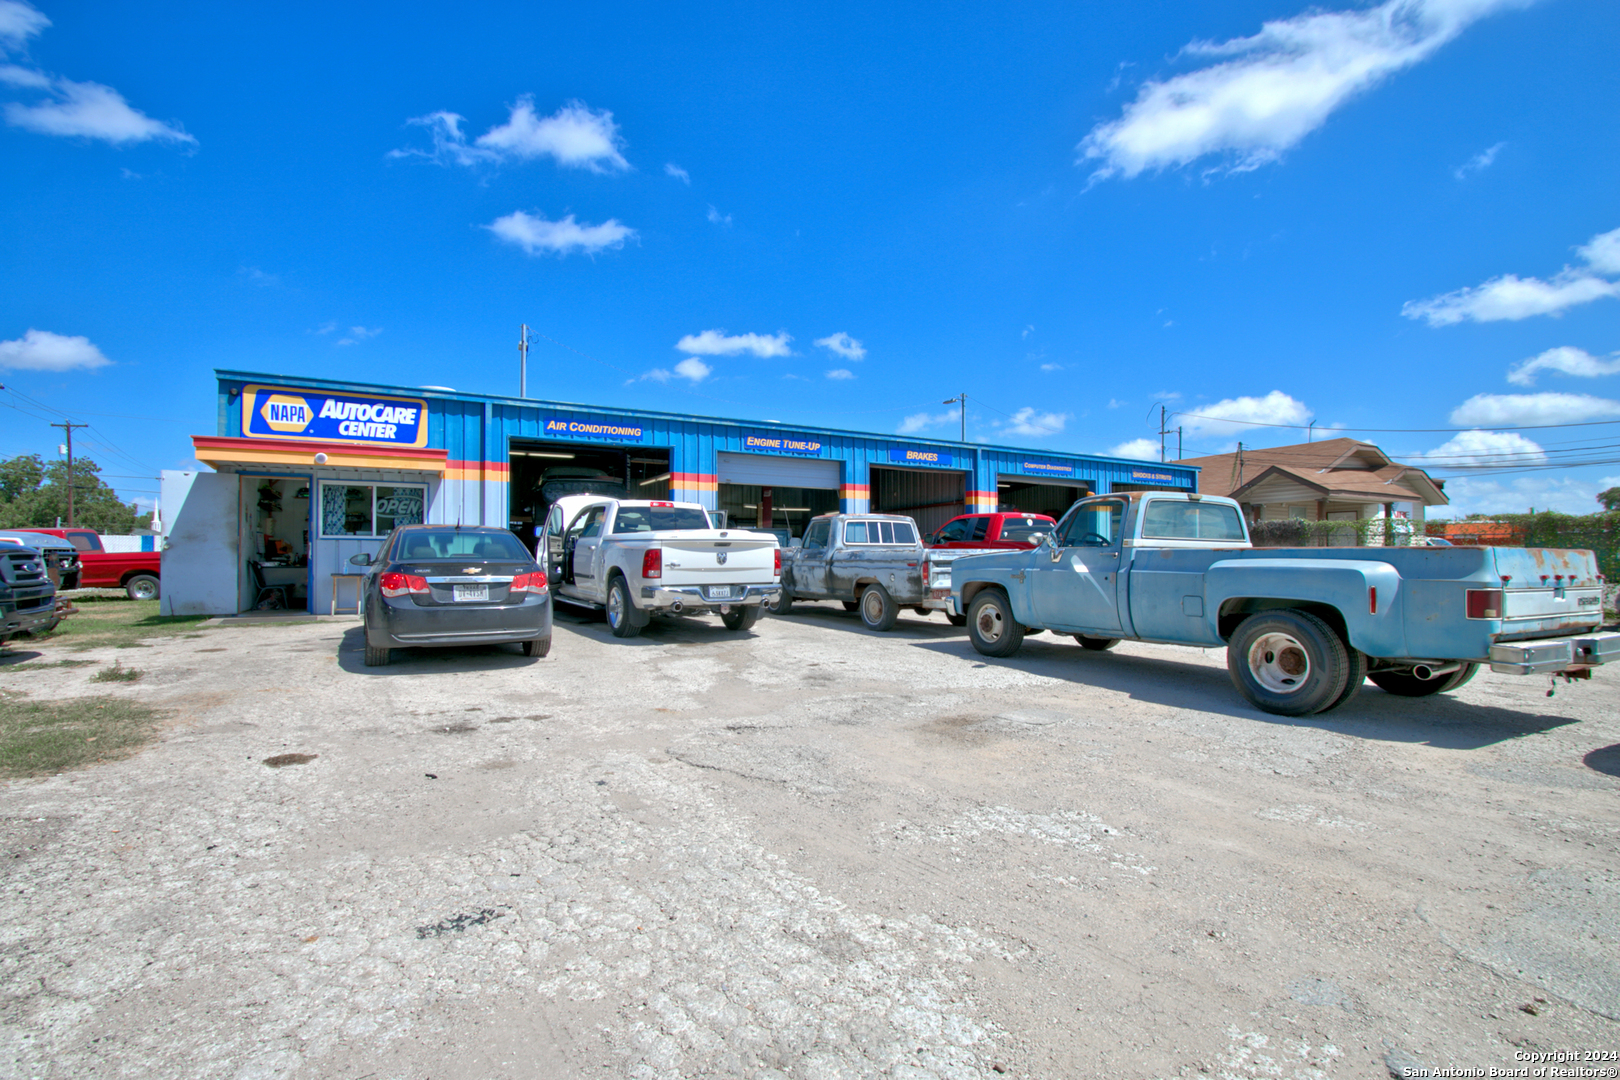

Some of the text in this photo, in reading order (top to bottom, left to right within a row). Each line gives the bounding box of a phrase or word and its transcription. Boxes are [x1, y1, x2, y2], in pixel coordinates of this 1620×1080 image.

[271, 404, 305, 422] NAPA
[319, 399, 416, 425] AUTOCARE
[338, 421, 397, 439] CENTER
[547, 420, 641, 436] AIR CONDITIONING
[746, 436, 821, 451] ENGINE TUNE-UP
[906, 450, 938, 462] BRAKES
[377, 499, 419, 514] OPEN
